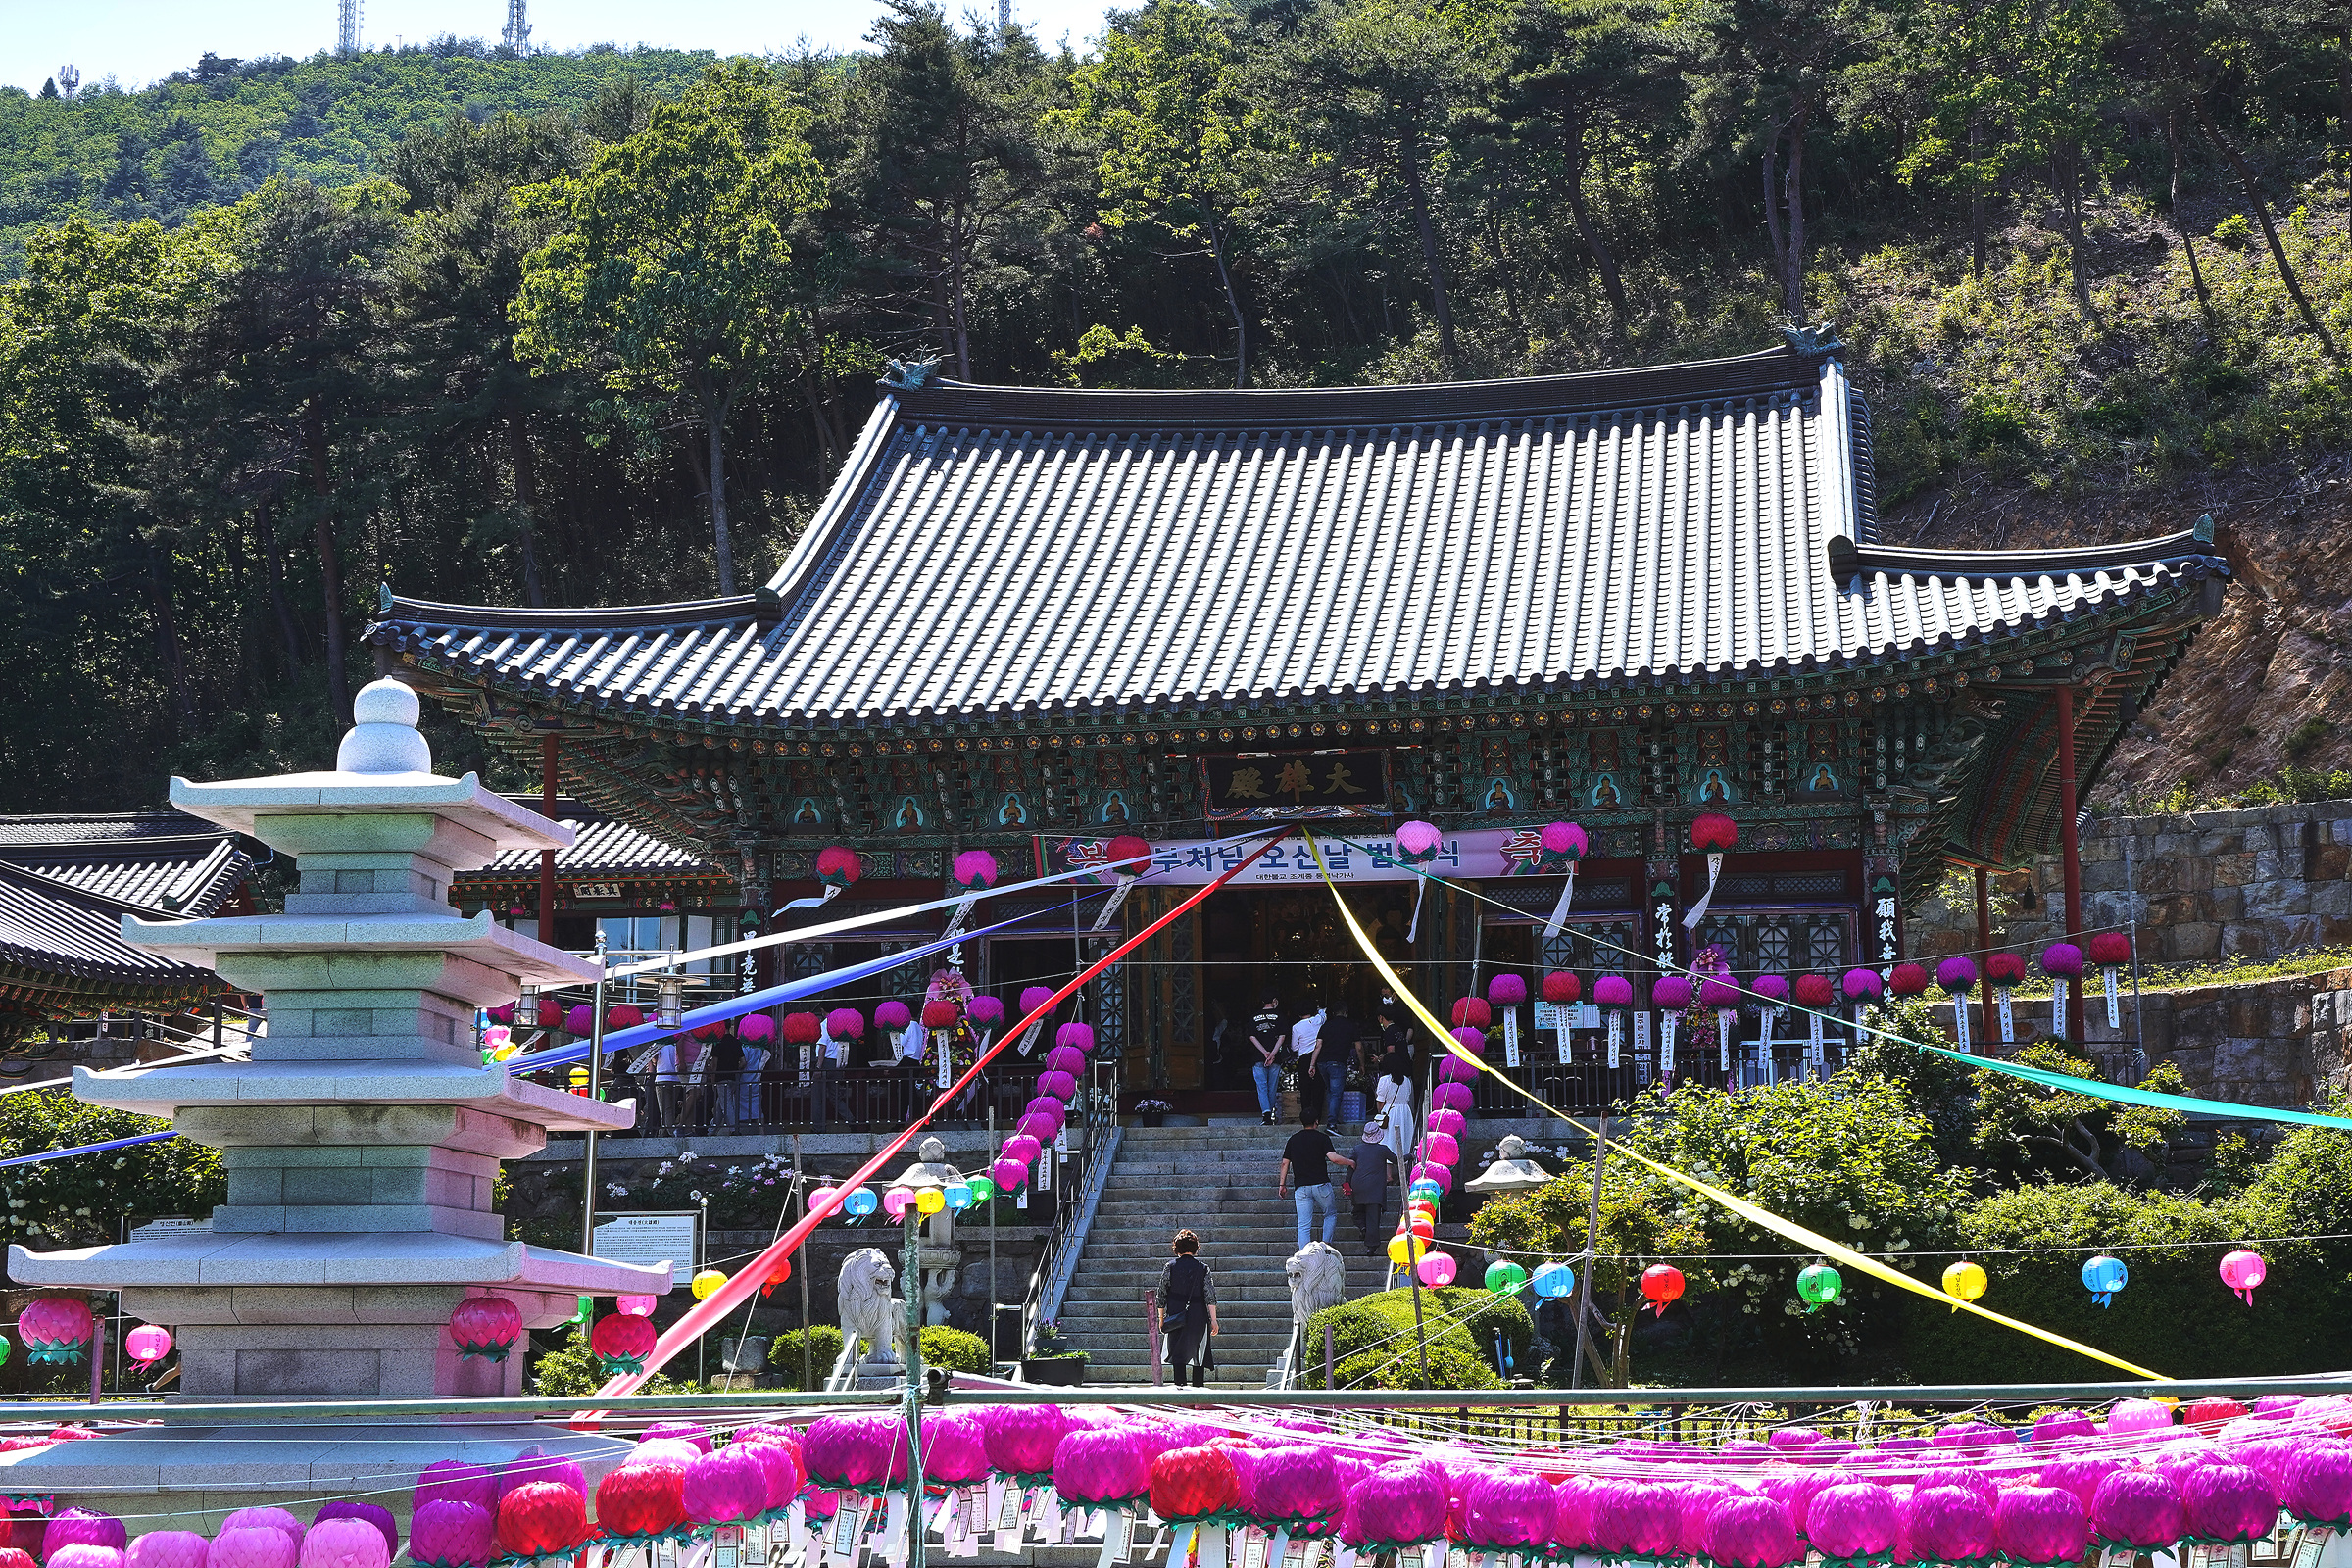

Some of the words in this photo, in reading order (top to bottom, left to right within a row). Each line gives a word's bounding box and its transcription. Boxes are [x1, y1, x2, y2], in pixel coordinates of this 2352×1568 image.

[1224, 760, 1367, 803] 大雄殿
[1152, 846, 1244, 873] 부처님
[1258, 843, 1352, 870] 오신날
[1366, 841, 1460, 869] 법식
